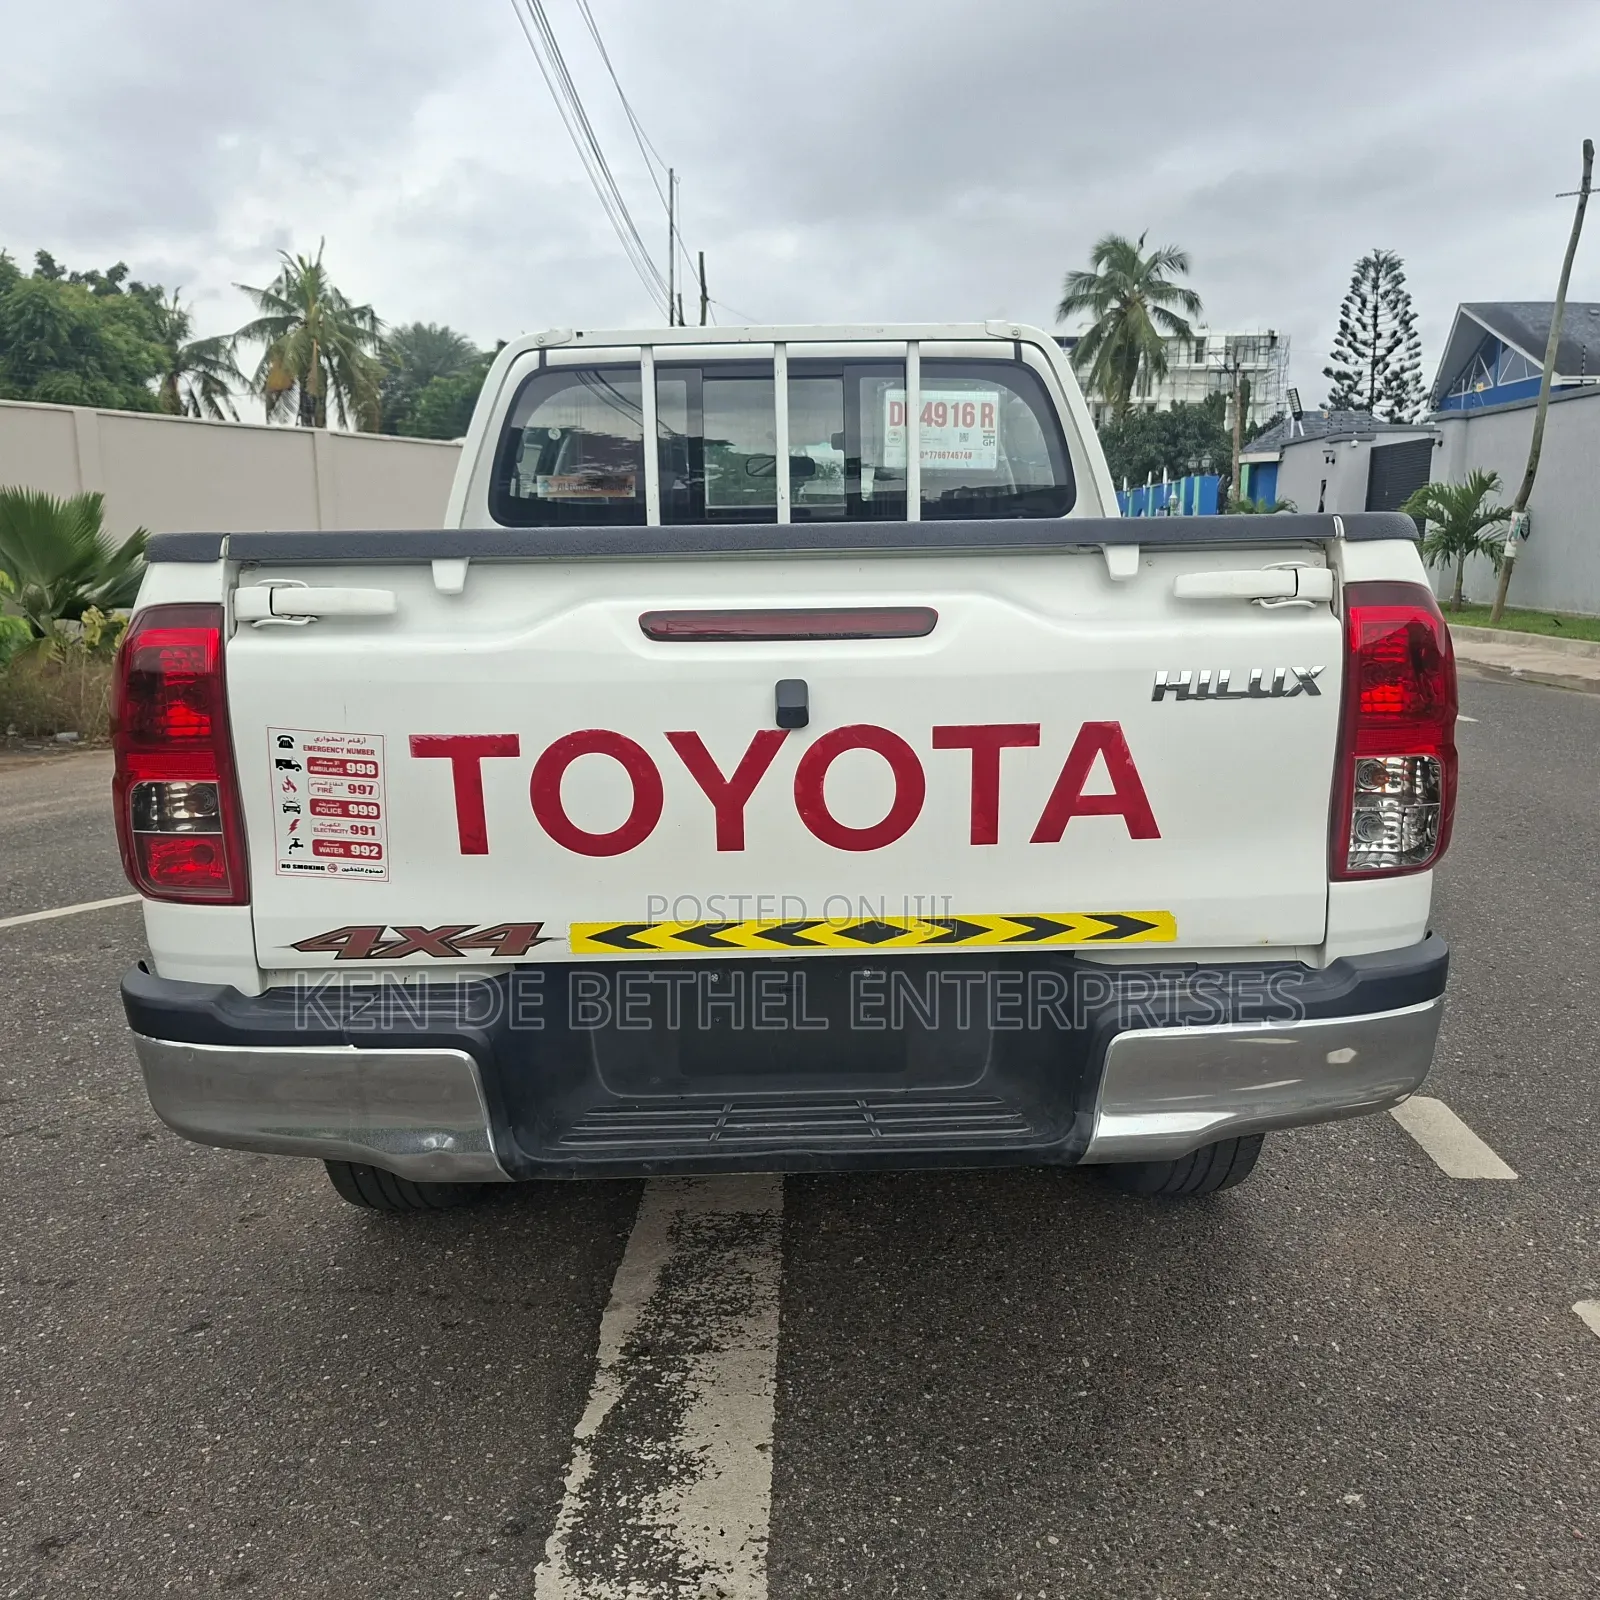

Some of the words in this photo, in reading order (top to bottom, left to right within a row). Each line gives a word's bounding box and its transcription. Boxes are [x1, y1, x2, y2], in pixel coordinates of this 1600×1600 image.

[889, 402, 907, 427] D
[920, 402, 975, 428] 4916
[980, 403, 994, 428] R
[983, 439, 995, 447] GH
[1151, 665, 1326, 702] HILUX
[303, 745, 344, 754] EMERGENCY
[346, 747, 375, 756] NUMBER
[310, 766, 344, 774] AMBULANCE
[346, 763, 376, 775] 998
[317, 786, 333, 794] FIRE
[347, 783, 374, 796] 997
[409, 721, 1161, 858] TOYOTA
[316, 806, 343, 815] POLICE
[348, 804, 378, 817] 999
[313, 827, 348, 835] ELECTRICITY
[350, 824, 376, 836] 991
[318, 846, 344, 854] WATER
[350, 844, 379, 857] 992
